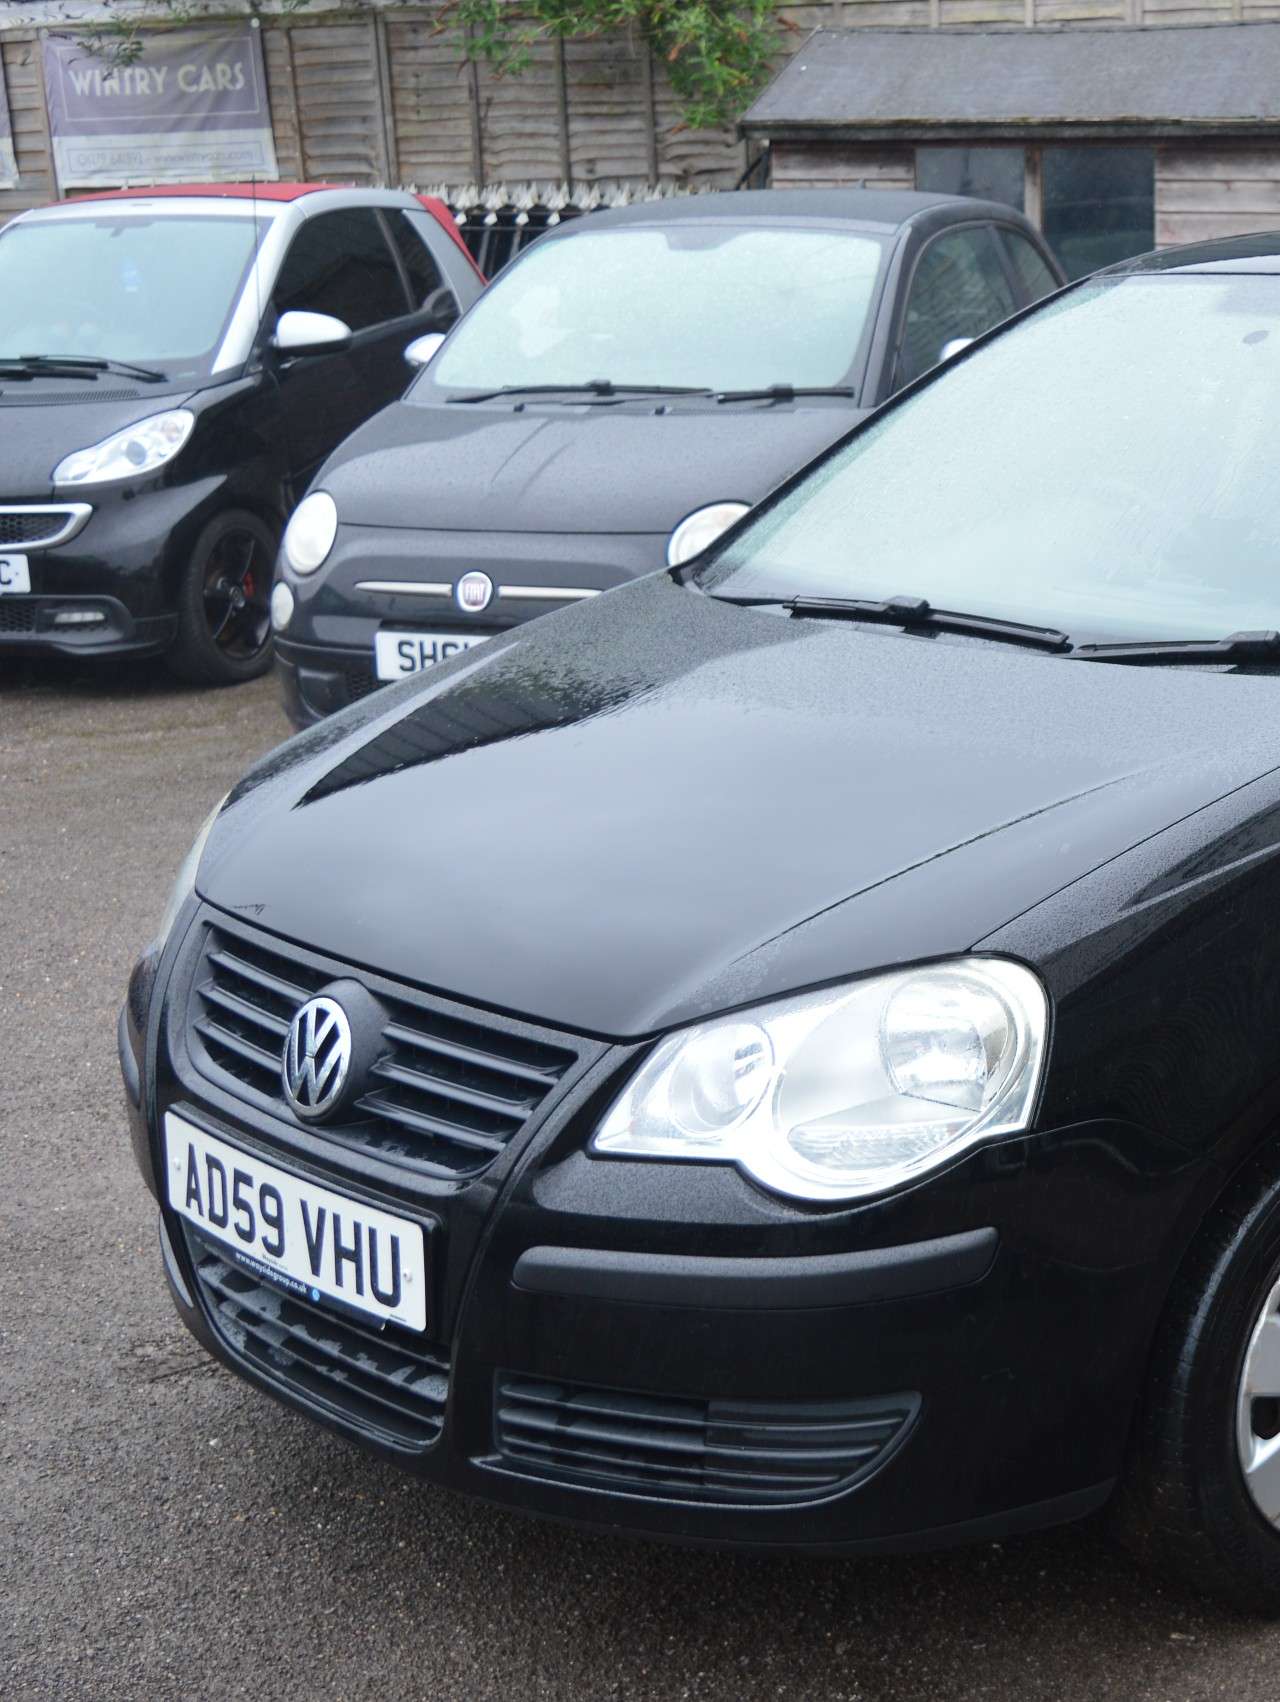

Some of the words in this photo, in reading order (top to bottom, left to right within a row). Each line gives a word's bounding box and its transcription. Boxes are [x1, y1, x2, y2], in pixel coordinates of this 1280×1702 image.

[68, 65, 170, 97] WINTRY
[177, 61, 245, 93] CARS
[185, 1142, 286, 1258] AD59
[300, 1197, 400, 1308] VHU
